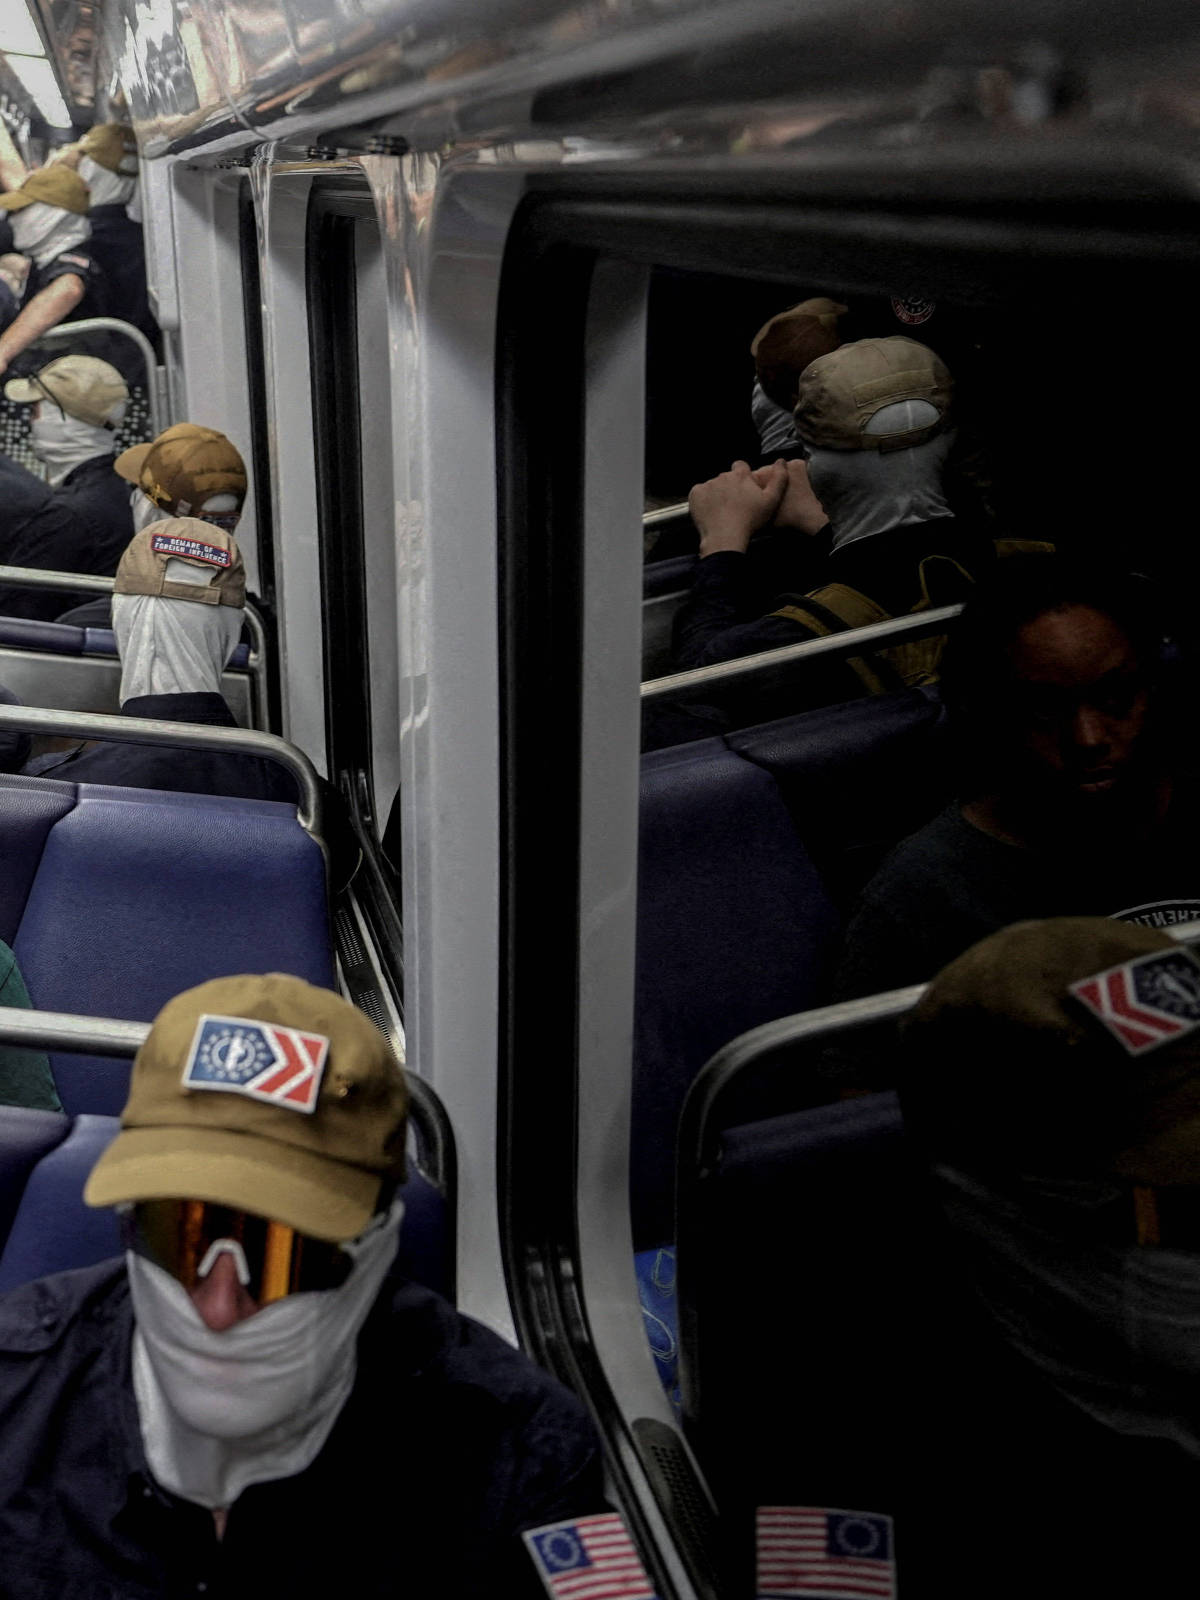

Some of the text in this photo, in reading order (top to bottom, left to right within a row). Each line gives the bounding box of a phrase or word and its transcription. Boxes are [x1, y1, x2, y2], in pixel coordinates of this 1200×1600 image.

[154, 542, 227, 564] FOREIGN INFLUENCE
[170, 538, 213, 553] BEWARE OF
